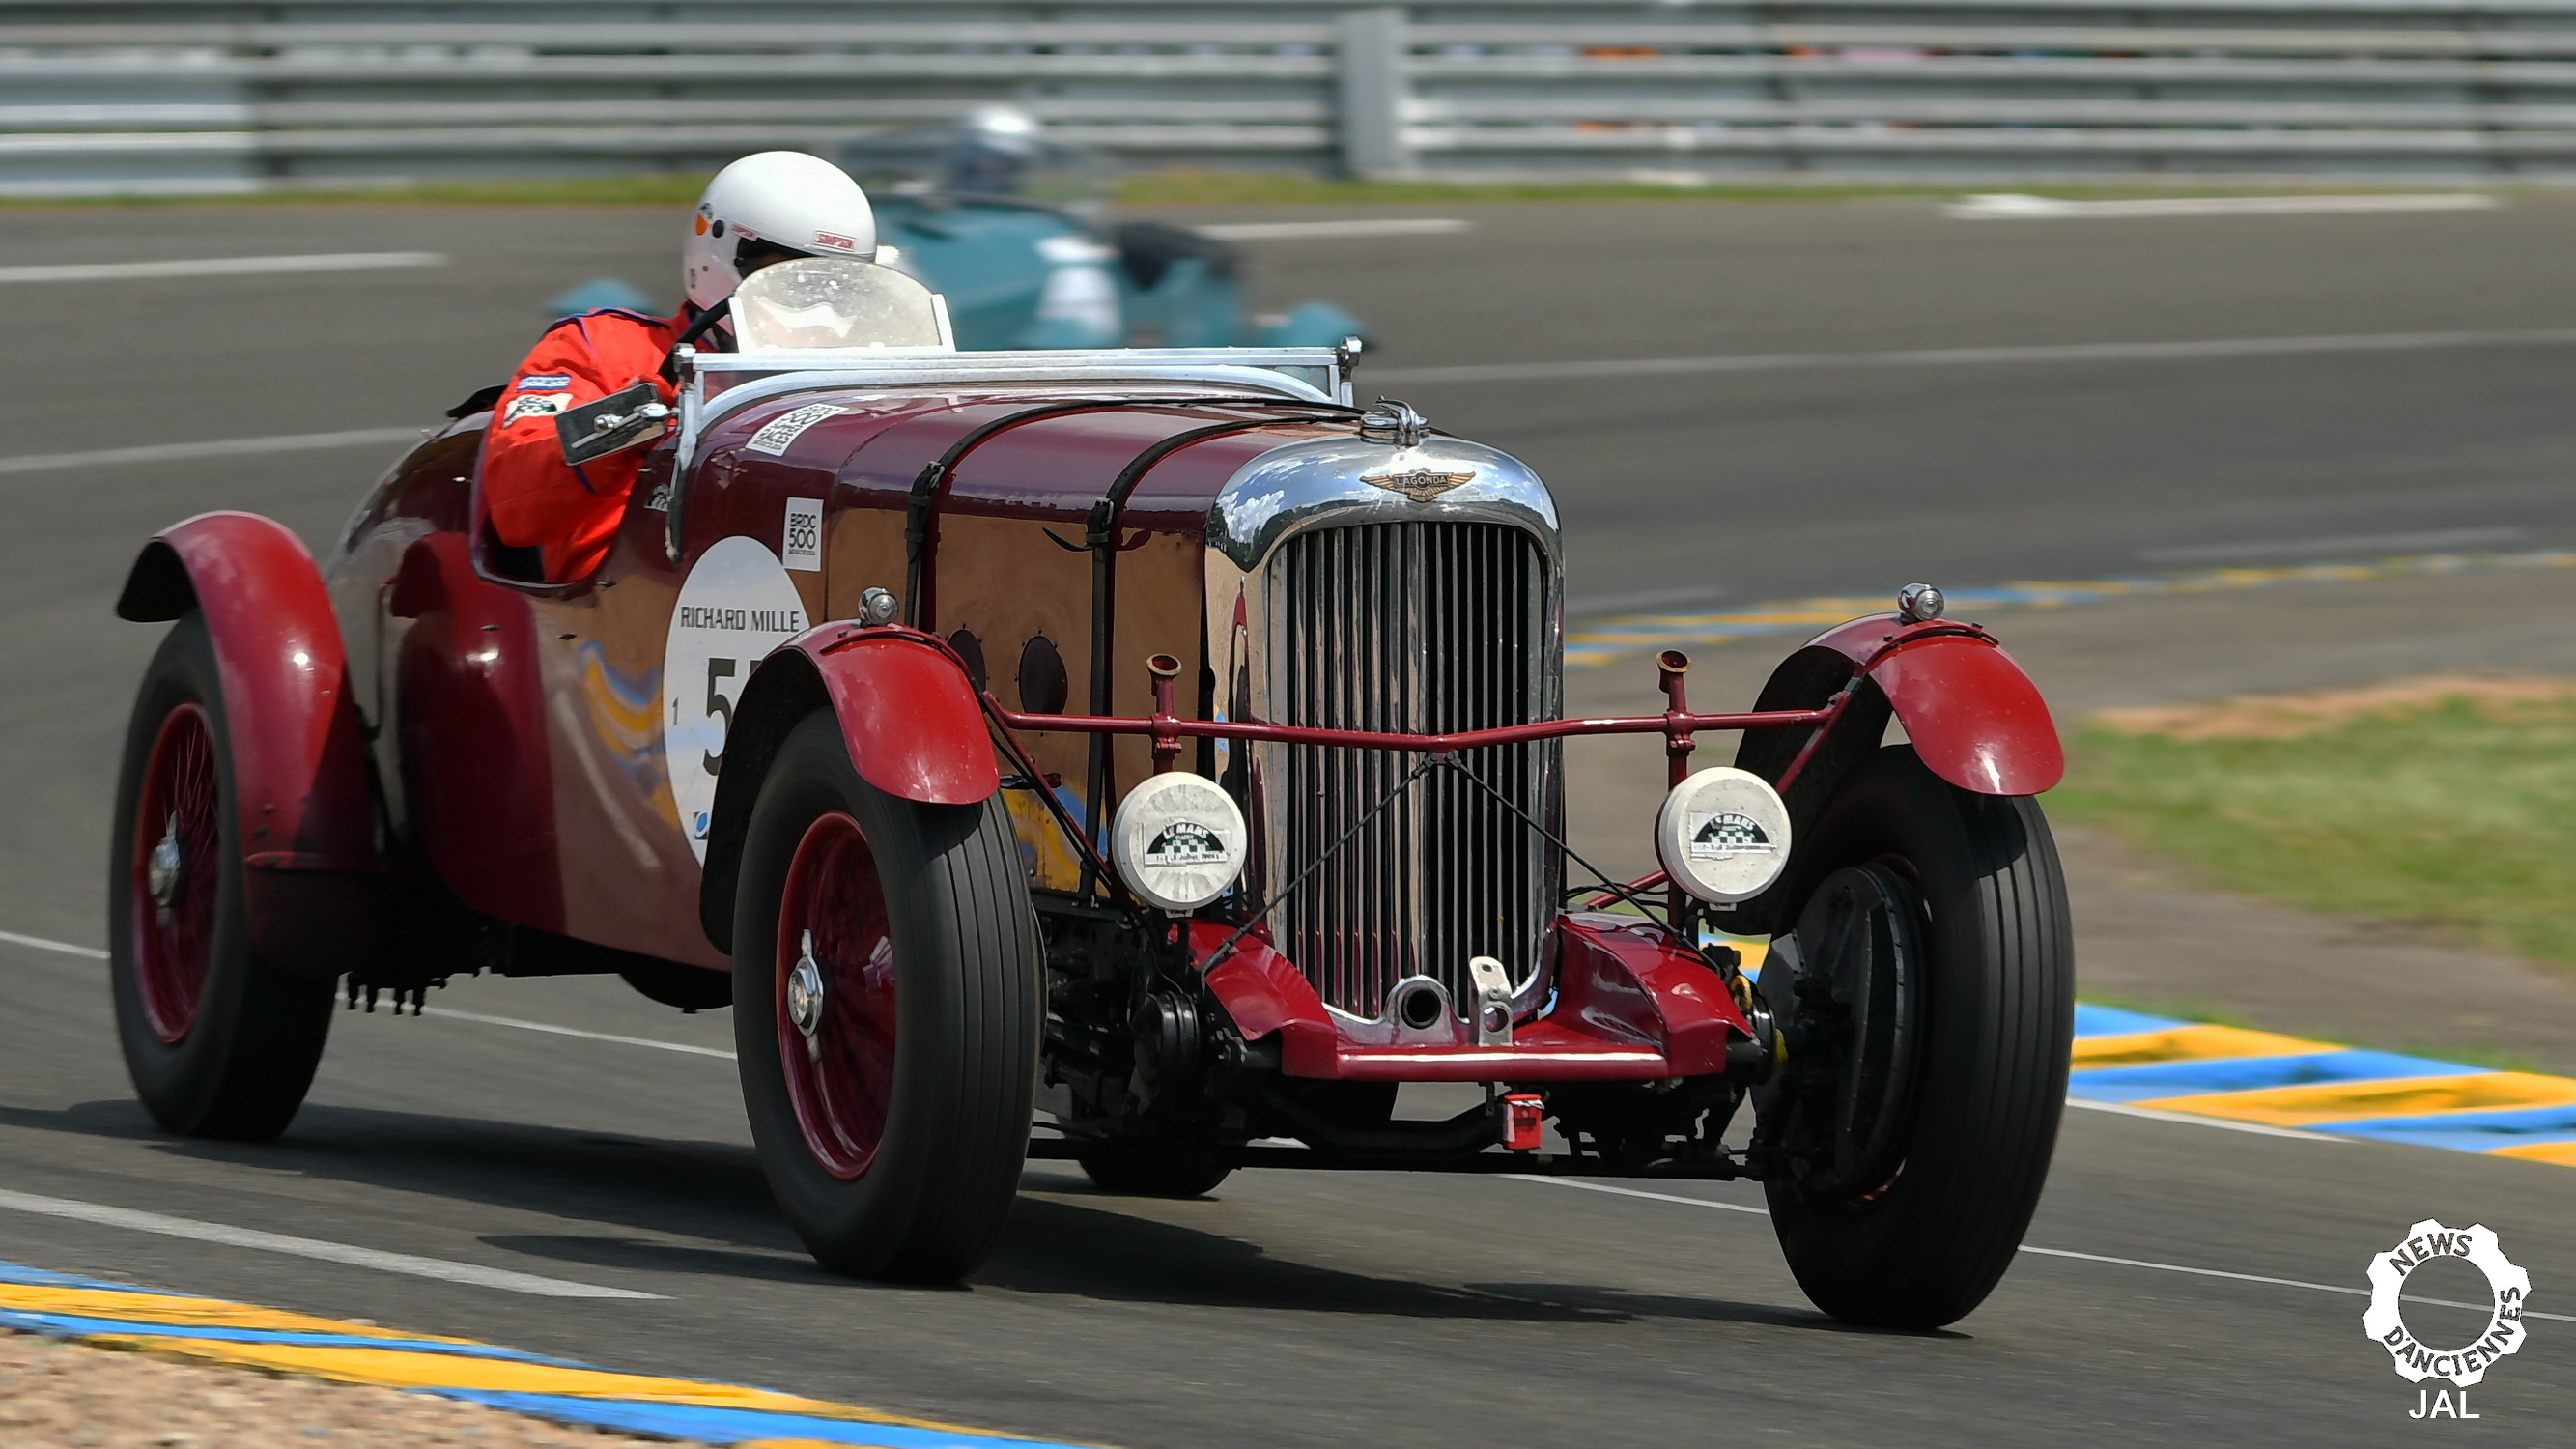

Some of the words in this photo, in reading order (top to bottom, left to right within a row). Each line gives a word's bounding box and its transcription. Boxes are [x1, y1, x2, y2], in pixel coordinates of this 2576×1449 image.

[1397, 475, 1447, 486] LAGONDA
[790, 512, 817, 529] BRDC
[788, 527, 817, 550] 500
[680, 606, 746, 631] RICHARD
[750, 610, 800, 633] MILLE
[1176, 824, 1209, 838] MANS
